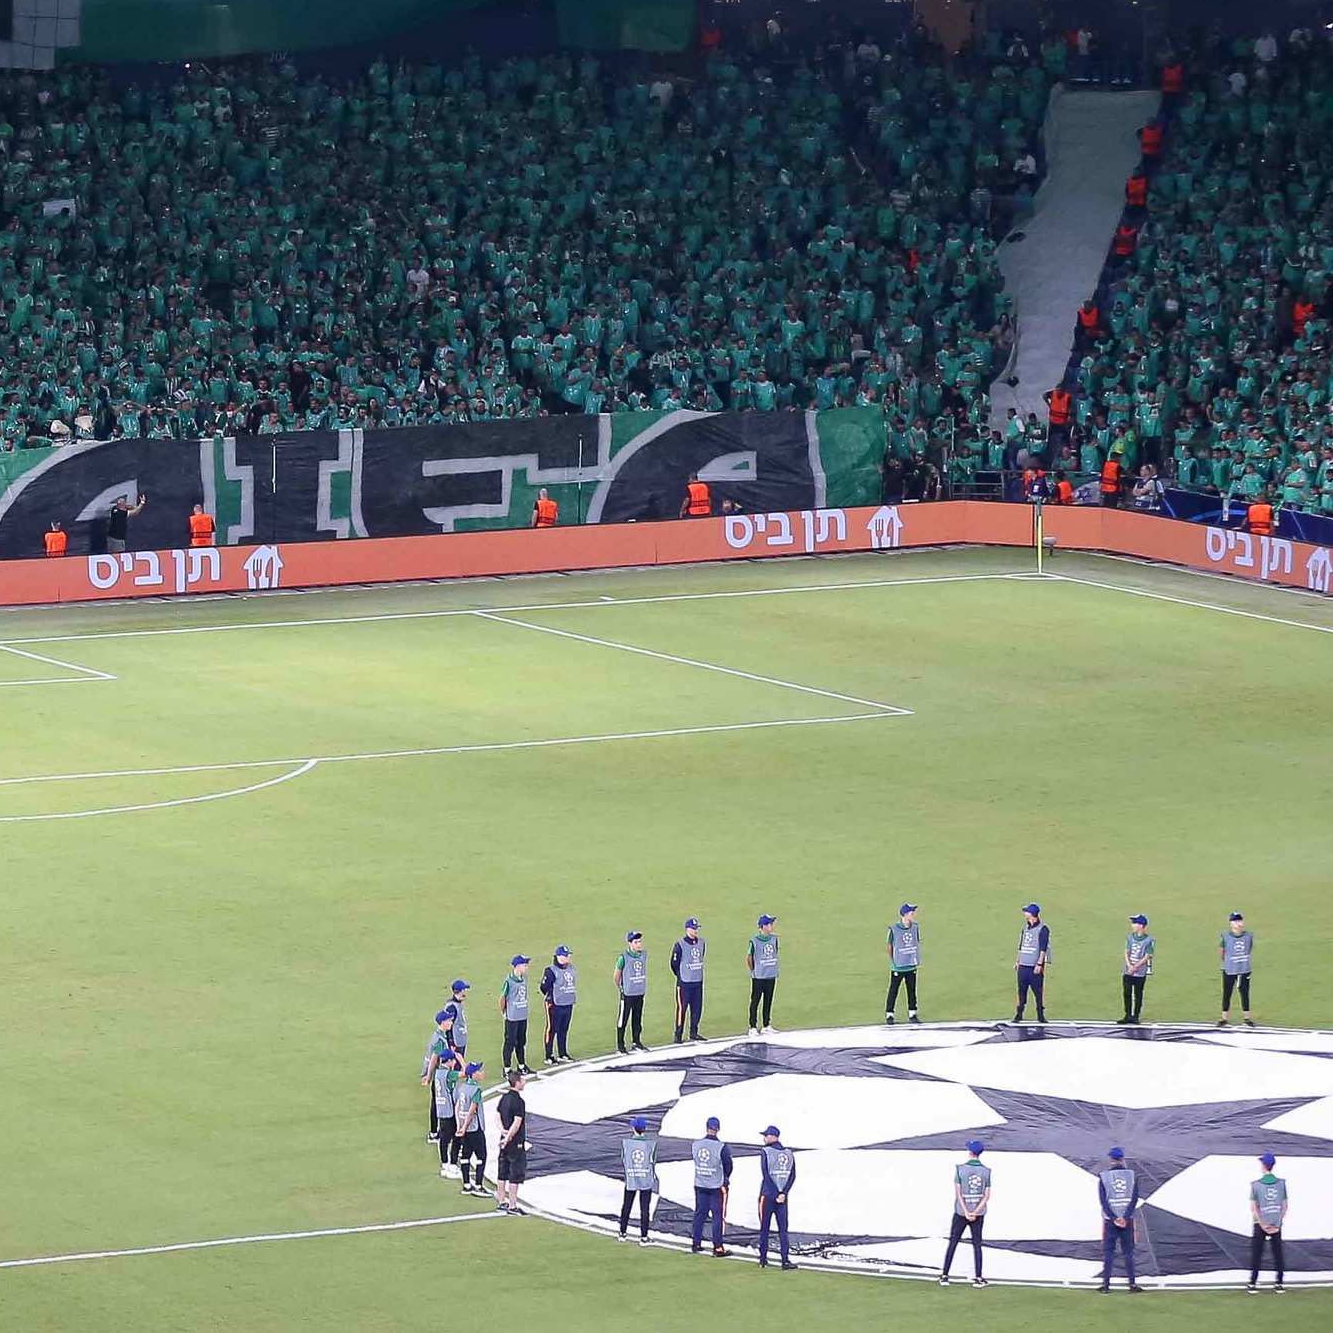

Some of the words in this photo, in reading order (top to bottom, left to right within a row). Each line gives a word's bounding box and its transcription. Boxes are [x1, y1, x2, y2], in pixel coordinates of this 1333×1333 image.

[724, 513, 793, 549] ביס
[801, 507, 846, 553] תן
[1206, 527, 1254, 567] ביס
[88, 551, 163, 589] ביס
[171, 547, 221, 593] תן
[1261, 536, 1292, 580] תן
